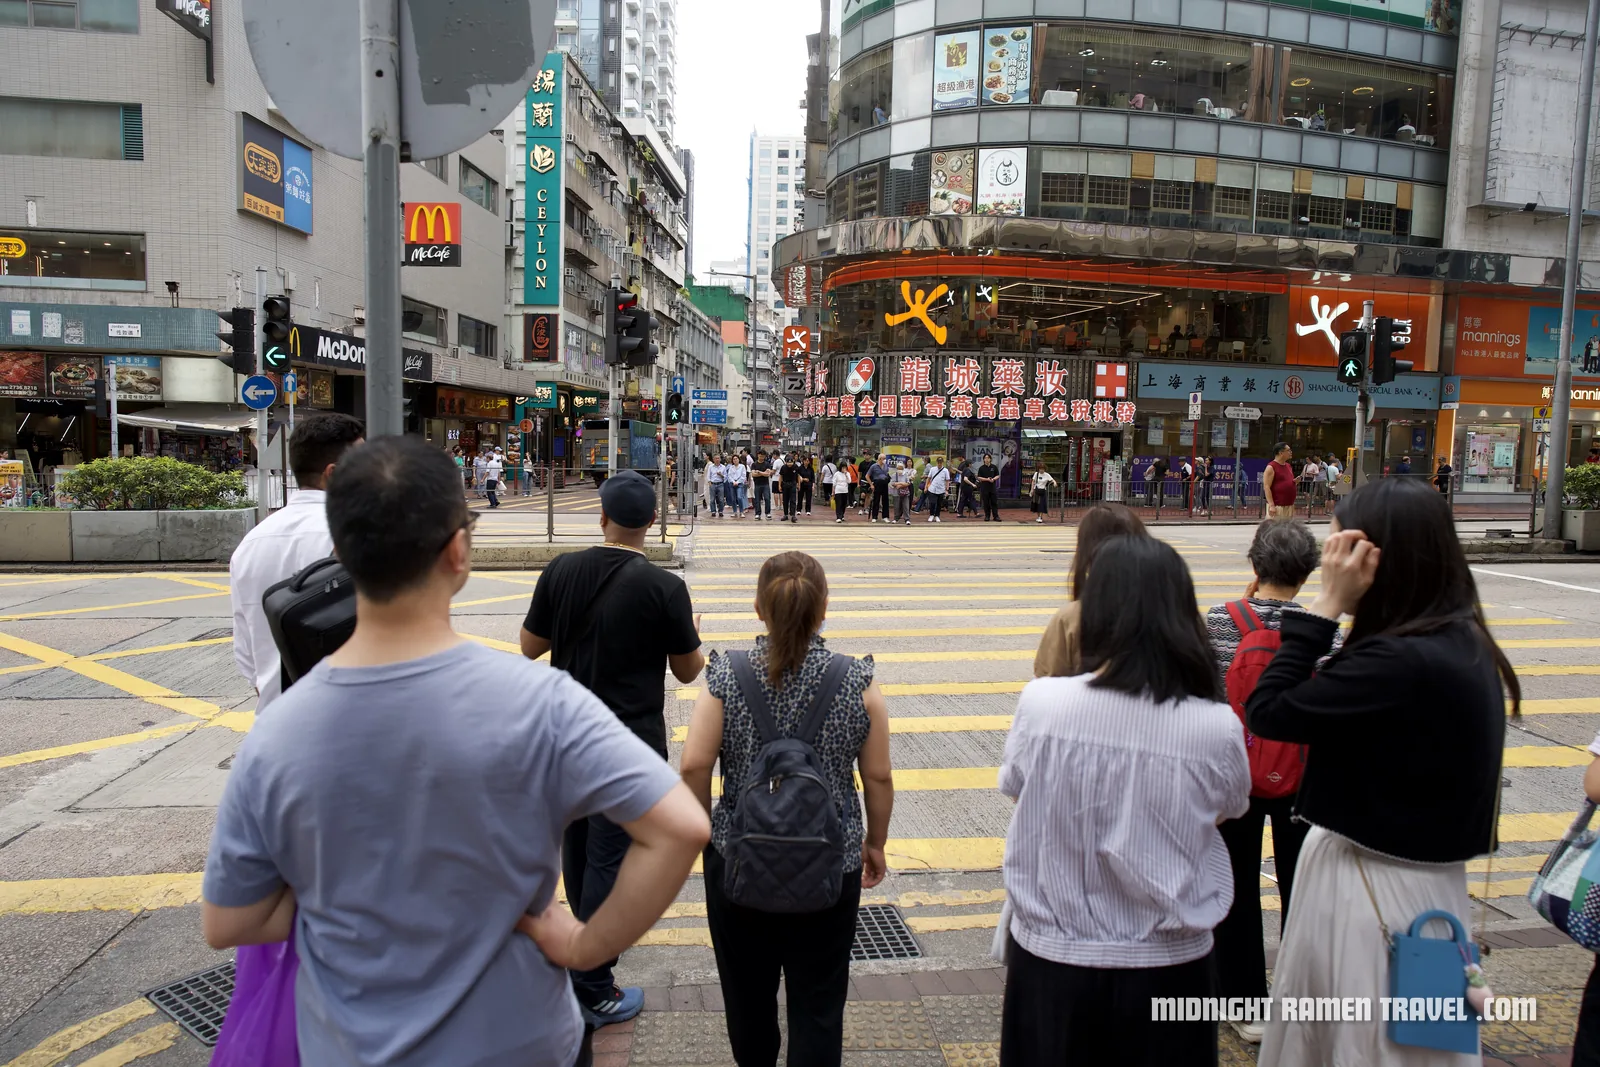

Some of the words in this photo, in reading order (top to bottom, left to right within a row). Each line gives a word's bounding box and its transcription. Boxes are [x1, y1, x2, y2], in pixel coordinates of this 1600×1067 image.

[937, 79, 975, 93] 超級漁港
[532, 69, 555, 127] 錫蘭
[535, 189, 547, 288] CEYLON
[411, 246, 451, 262] McCafé
[1464, 316, 1482, 328] 萬寧
[1462, 331, 1521, 347] mannings
[860, 363, 871, 373] 正
[900, 357, 1068, 396] 龍城藥妝
[1142, 373, 1280, 394] 上海商業銀行
[1308, 384, 1344, 393] SHANGHAI
[1346, 385, 1392, 395] COERCIAL
[1394, 387, 1413, 396] BANK
[1570, 388, 1600, 400] anni
